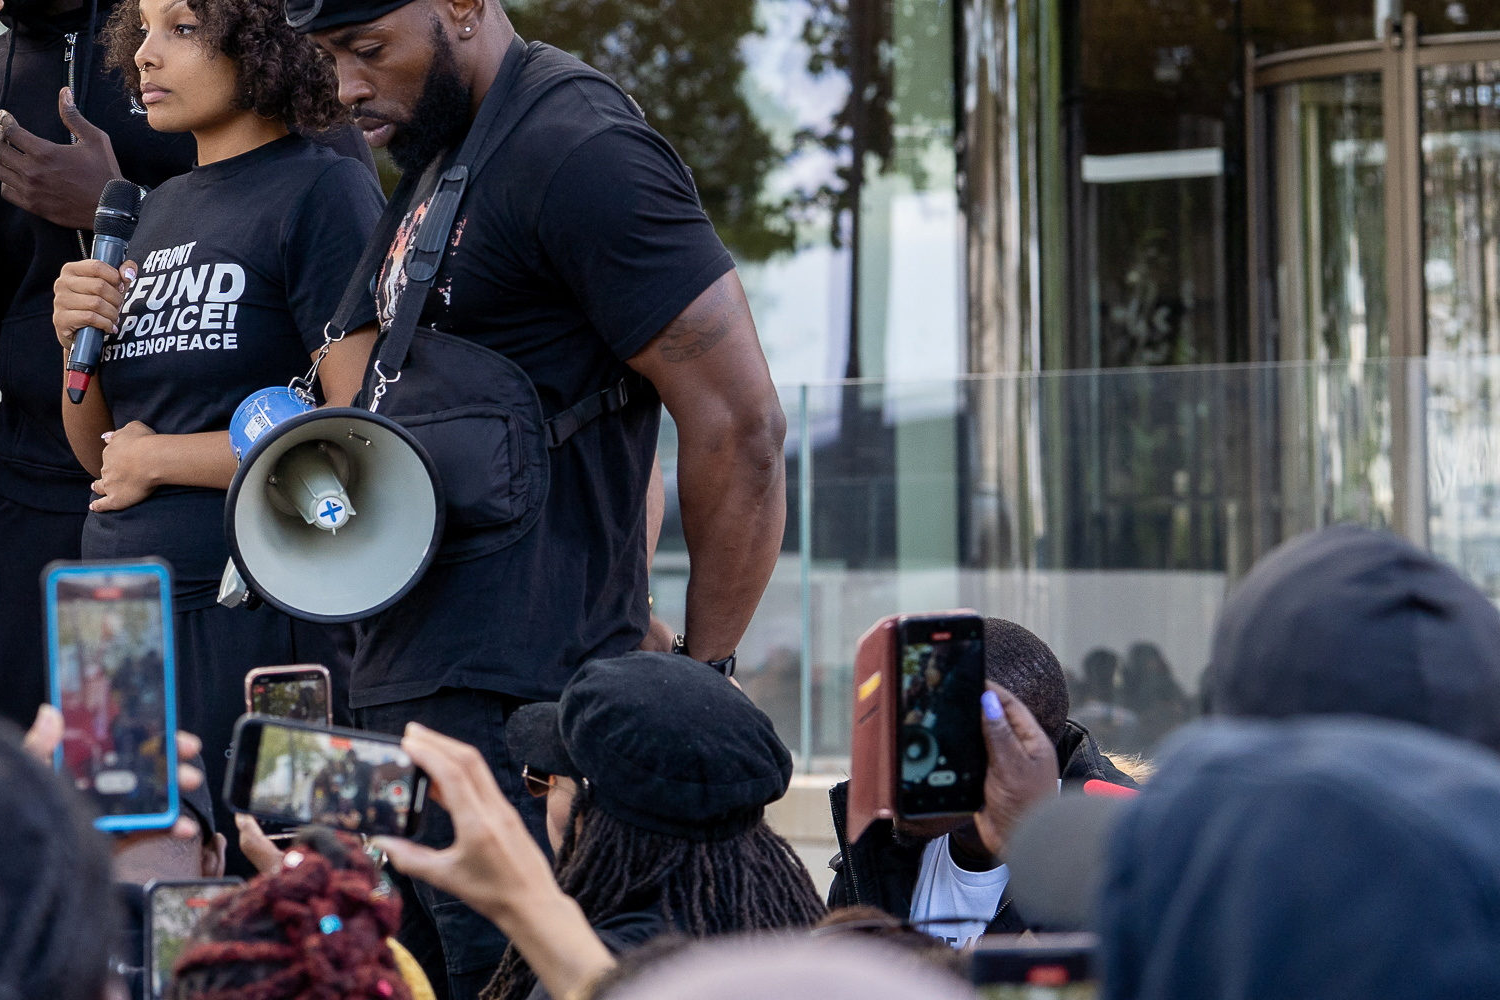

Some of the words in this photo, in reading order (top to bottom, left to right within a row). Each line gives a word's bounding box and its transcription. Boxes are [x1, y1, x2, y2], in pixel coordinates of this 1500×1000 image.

[142, 241, 197, 274] 4FRONT
[122, 262, 246, 314] FUND
[117, 303, 238, 341] POLICE!
